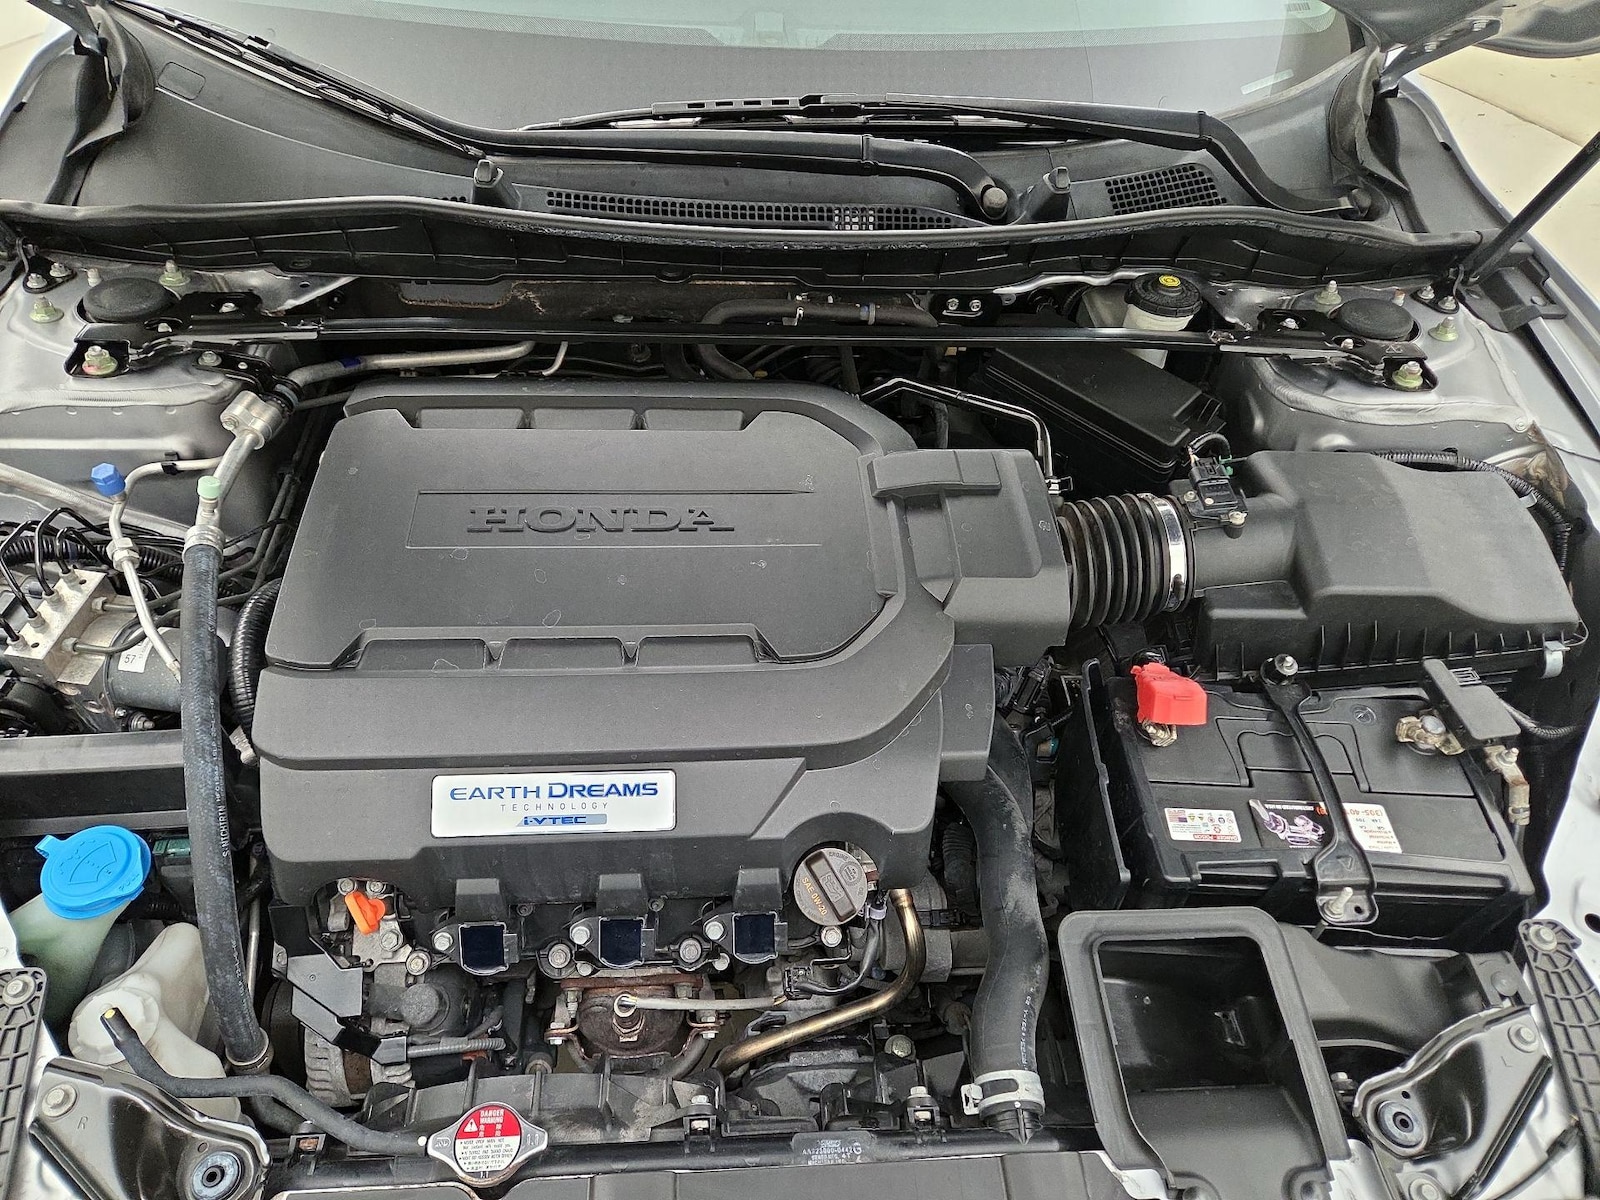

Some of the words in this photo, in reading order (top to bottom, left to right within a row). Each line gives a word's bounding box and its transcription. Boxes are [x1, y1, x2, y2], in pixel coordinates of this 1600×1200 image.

[466, 506, 735, 533] HONDA
[124, 654, 136, 664] 57
[450, 786, 541, 801] EARTH
[547, 782, 658, 799] DREAMS
[500, 802, 608, 812] TECHNOLOGY
[523, 815, 587, 826] i-VTEC
[802, 877, 815, 893] SAE
[811, 893, 828, 916] 0W-20
[480, 1109, 505, 1117] DANGER
